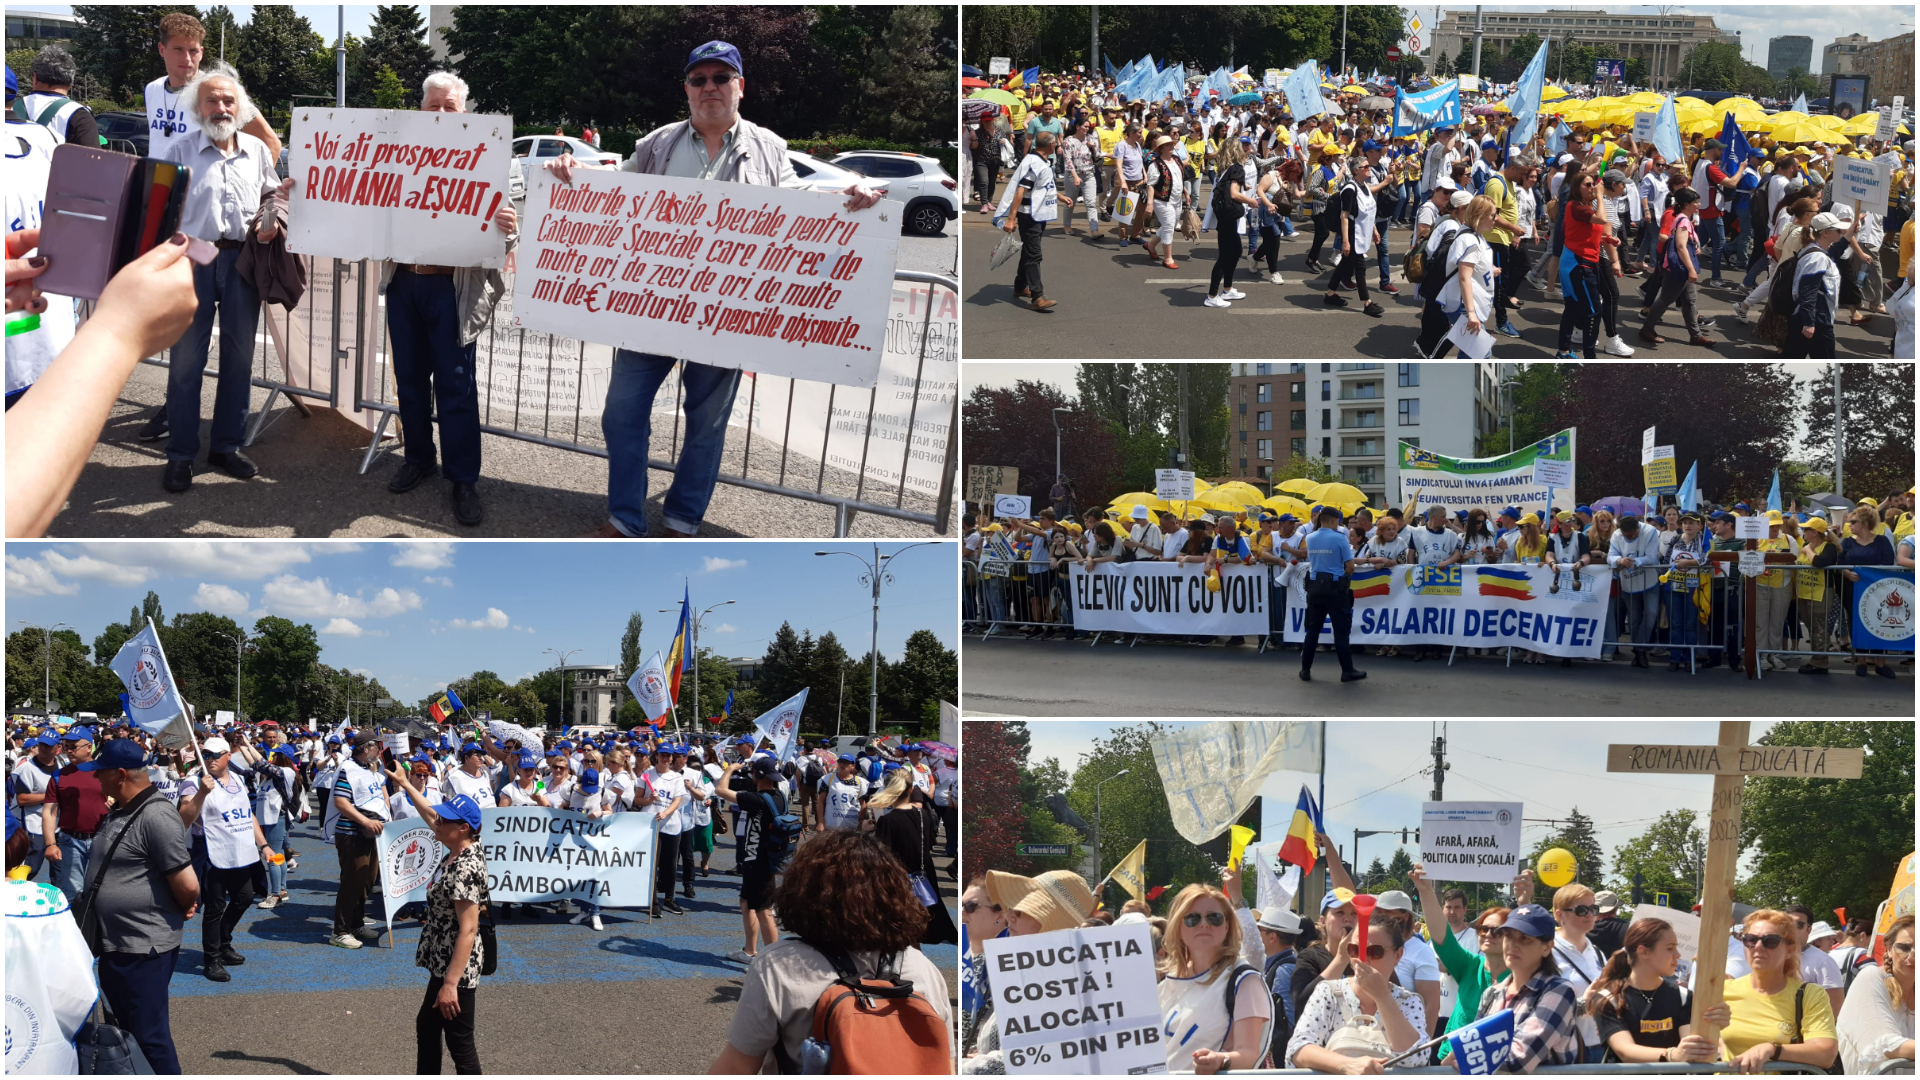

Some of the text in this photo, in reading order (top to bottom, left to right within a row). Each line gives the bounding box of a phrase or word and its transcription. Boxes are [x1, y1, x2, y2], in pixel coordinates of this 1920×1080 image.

[151, 120, 187, 134] ARAD
[342, 132, 374, 168] ați
[370, 142, 488, 176] prosperat
[306, 165, 404, 208] ROMÂNIA
[549, 183, 626, 216] Veniturile
[627, 191, 648, 223] și
[706, 198, 786, 238] Speciale
[782, 212, 860, 246] pentru
[536, 213, 863, 281] Categoriile Speciale care întrec de
[536, 248, 588, 274] multe
[621, 256, 647, 283] de
[646, 262, 694, 289] zeci
[690, 266, 718, 293] de
[754, 276, 782, 304] de
[780, 280, 842, 310] multe
[532, 275, 566, 304] mii
[606, 288, 698, 324] veniturile
[698, 300, 723, 330] și
[712, 306, 785, 338] pensiile
[1485, 492, 1504, 504] FEN
[1424, 566, 1461, 583] FSE
[1076, 574, 1264, 614] ELEVII SUNT CU VOI!
[1360, 607, 1456, 635] SALARII
[1464, 608, 1598, 646] DECENTE!
[222, 808, 252, 822] FSLI
[1712, 786, 1742, 814] 2018
[494, 816, 611, 838] SINDICATUL
[1435, 834, 1499, 849] AFARĂ, AFARĂ,
[1709, 818, 1739, 842] 2023
[512, 840, 646, 871] ÎNVĂȚĂMÂNT
[1422, 852, 1515, 868] POLITICA DIN ȘCOALĂ!
[488, 870, 612, 900] DÂMBOVIȚA
[998, 938, 1142, 972] EDUCAȚIA
[1003, 970, 1100, 1004] COSTĂ
[24, 1006, 36, 1020] DIN
[1004, 1001, 1124, 1036] ALOCAȚI
[1009, 1026, 1160, 1068] 6% DIN PIB
